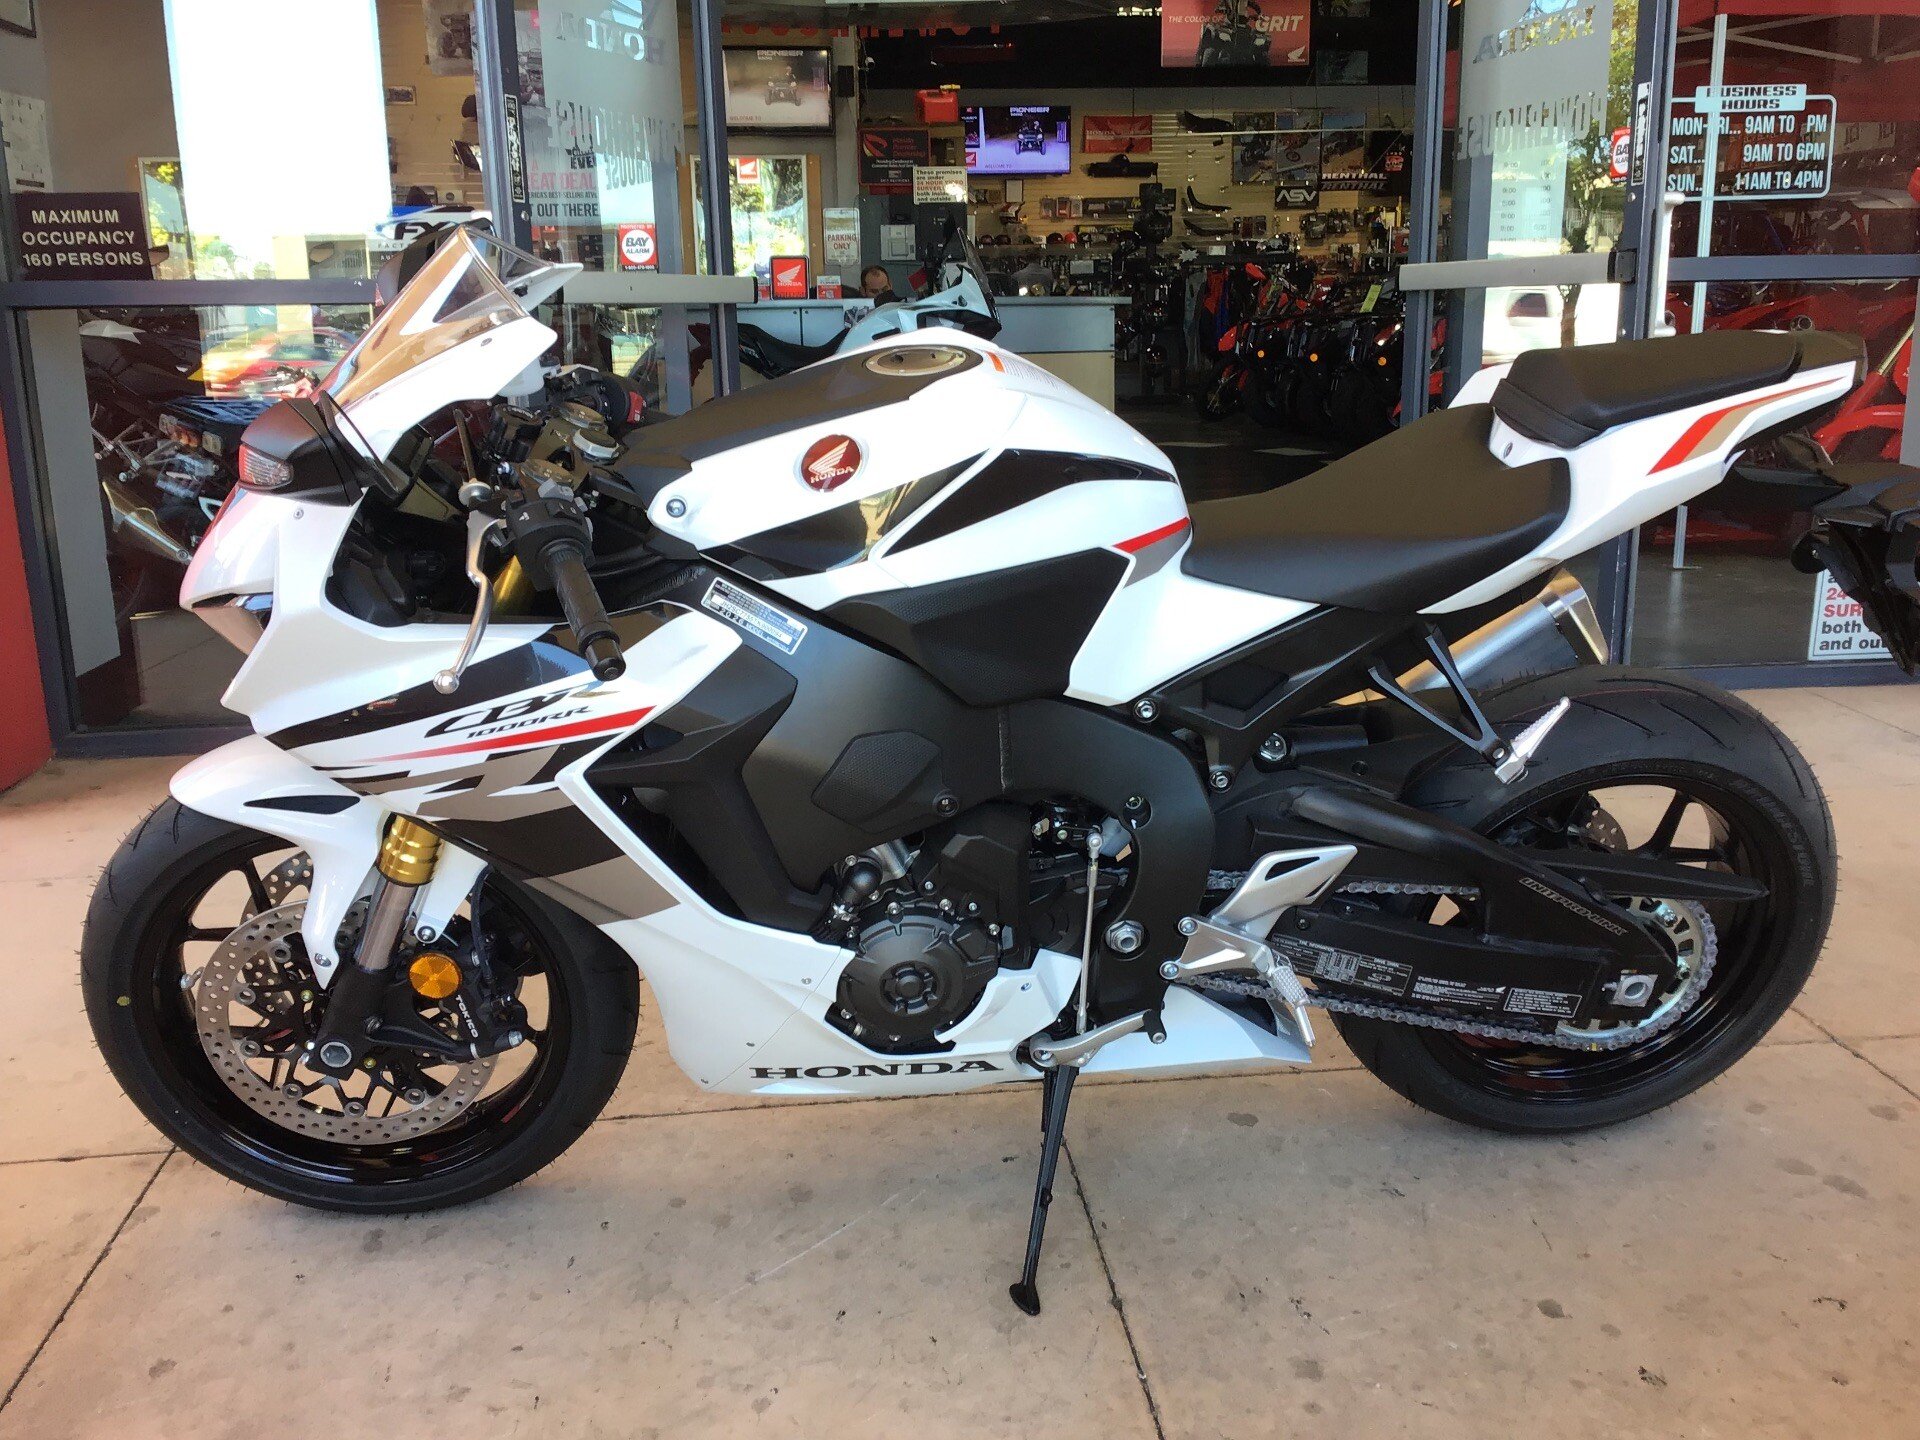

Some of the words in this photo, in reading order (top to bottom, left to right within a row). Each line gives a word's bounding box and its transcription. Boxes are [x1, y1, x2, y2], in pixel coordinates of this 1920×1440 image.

[1168, 15, 1182, 23] THE
[1184, 15, 1210, 23] COLOR
[1255, 15, 1304, 33] GRIT
[1721, 98, 1781, 110] HOURS
[1745, 115, 1775, 134] 9AM
[1777, 115, 1796, 134] TO
[1743, 144, 1774, 162] 9AM
[1776, 143, 1794, 162] TO
[1796, 142, 1826, 161] 6PM
[1735, 171, 1772, 190] 11AM
[1774, 171, 1792, 190] TO
[1793, 170, 1824, 189] 4PM
[1276, 188, 1318, 203] ASV
[31, 209, 120, 224] MAXIMUM
[537, 203, 560, 217] OUT
[21, 230, 136, 246] OCCUPANCY
[625, 237, 650, 247] BAY
[827, 234, 858, 243] PARKING
[833, 242, 852, 251] ONLY
[22, 253, 52, 267] 160
[55, 251, 144, 266] PERSONS
[810, 465, 855, 484] HONDA
[1823, 603, 1864, 618] SUR
[1821, 620, 1862, 635] both
[1819, 637, 1852, 651] and
[466, 705, 594, 740] 1000RR
[455, 994, 479, 1039] TOKICO
[749, 1060, 1004, 1079] HONDA
